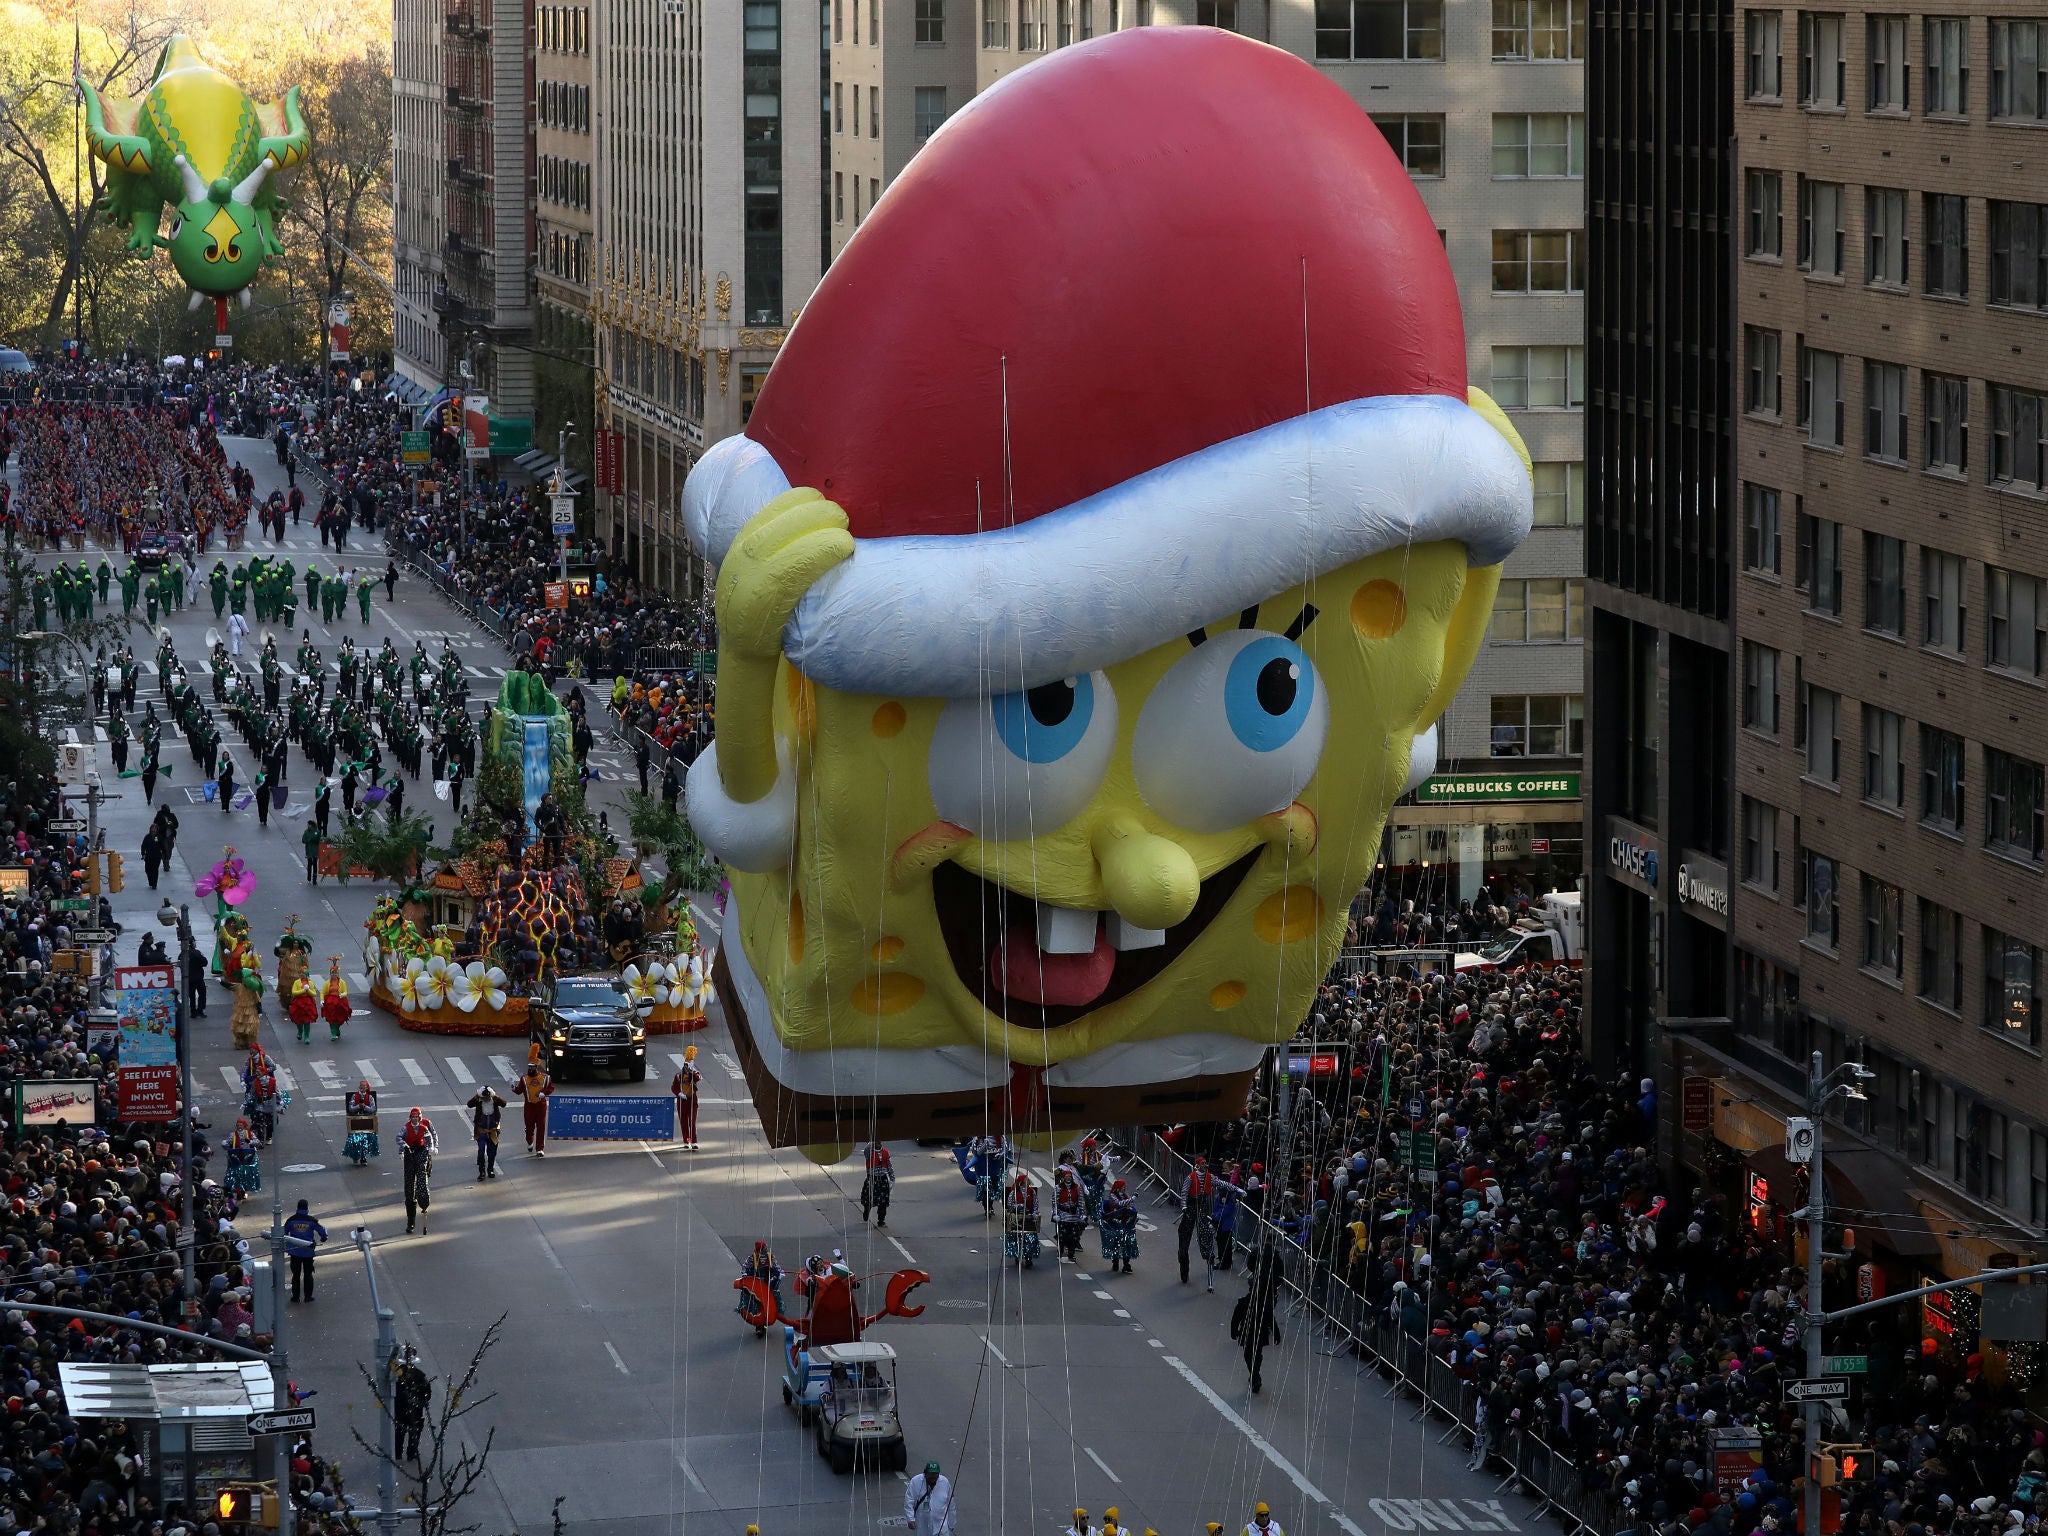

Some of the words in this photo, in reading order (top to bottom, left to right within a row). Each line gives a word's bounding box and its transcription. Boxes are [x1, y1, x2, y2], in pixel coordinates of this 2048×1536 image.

[555, 512, 571, 522] 25
[413, 630, 471, 639] ONLY
[1430, 782, 1512, 793] STARBUCKS
[1517, 780, 1568, 791] COFFEE
[1611, 837, 1646, 879] CHASE
[57, 901, 64, 909] W
[69, 900, 79, 909] 56
[121, 971, 168, 989] NYC
[124, 1072, 140, 1080] SEE
[142, 1071, 151, 1079] IT
[152, 1070, 172, 1079] LIVE
[136, 1082, 159, 1091] HERE
[131, 1094, 141, 1102] IN
[143, 1093, 164, 1101] NYC!
[571, 1114, 592, 1123] GOO
[596, 1115, 616, 1123] GOO
[621, 1115, 651, 1124] DOLLS
[1834, 1358, 1842, 1371] W
[1843, 1358, 1855, 1371] 55
[1793, 1386, 1812, 1395] ONE
[1820, 1384, 1840, 1393] WAY
[256, 1418, 276, 1429] ONE
[287, 1414, 309, 1425] WAY
[143, 1430, 152, 1477] Newsstand
[1718, 1476, 1729, 1485] Be
[1731, 1476, 1743, 1484] nic
[1368, 1497, 1522, 1533] ONLY
